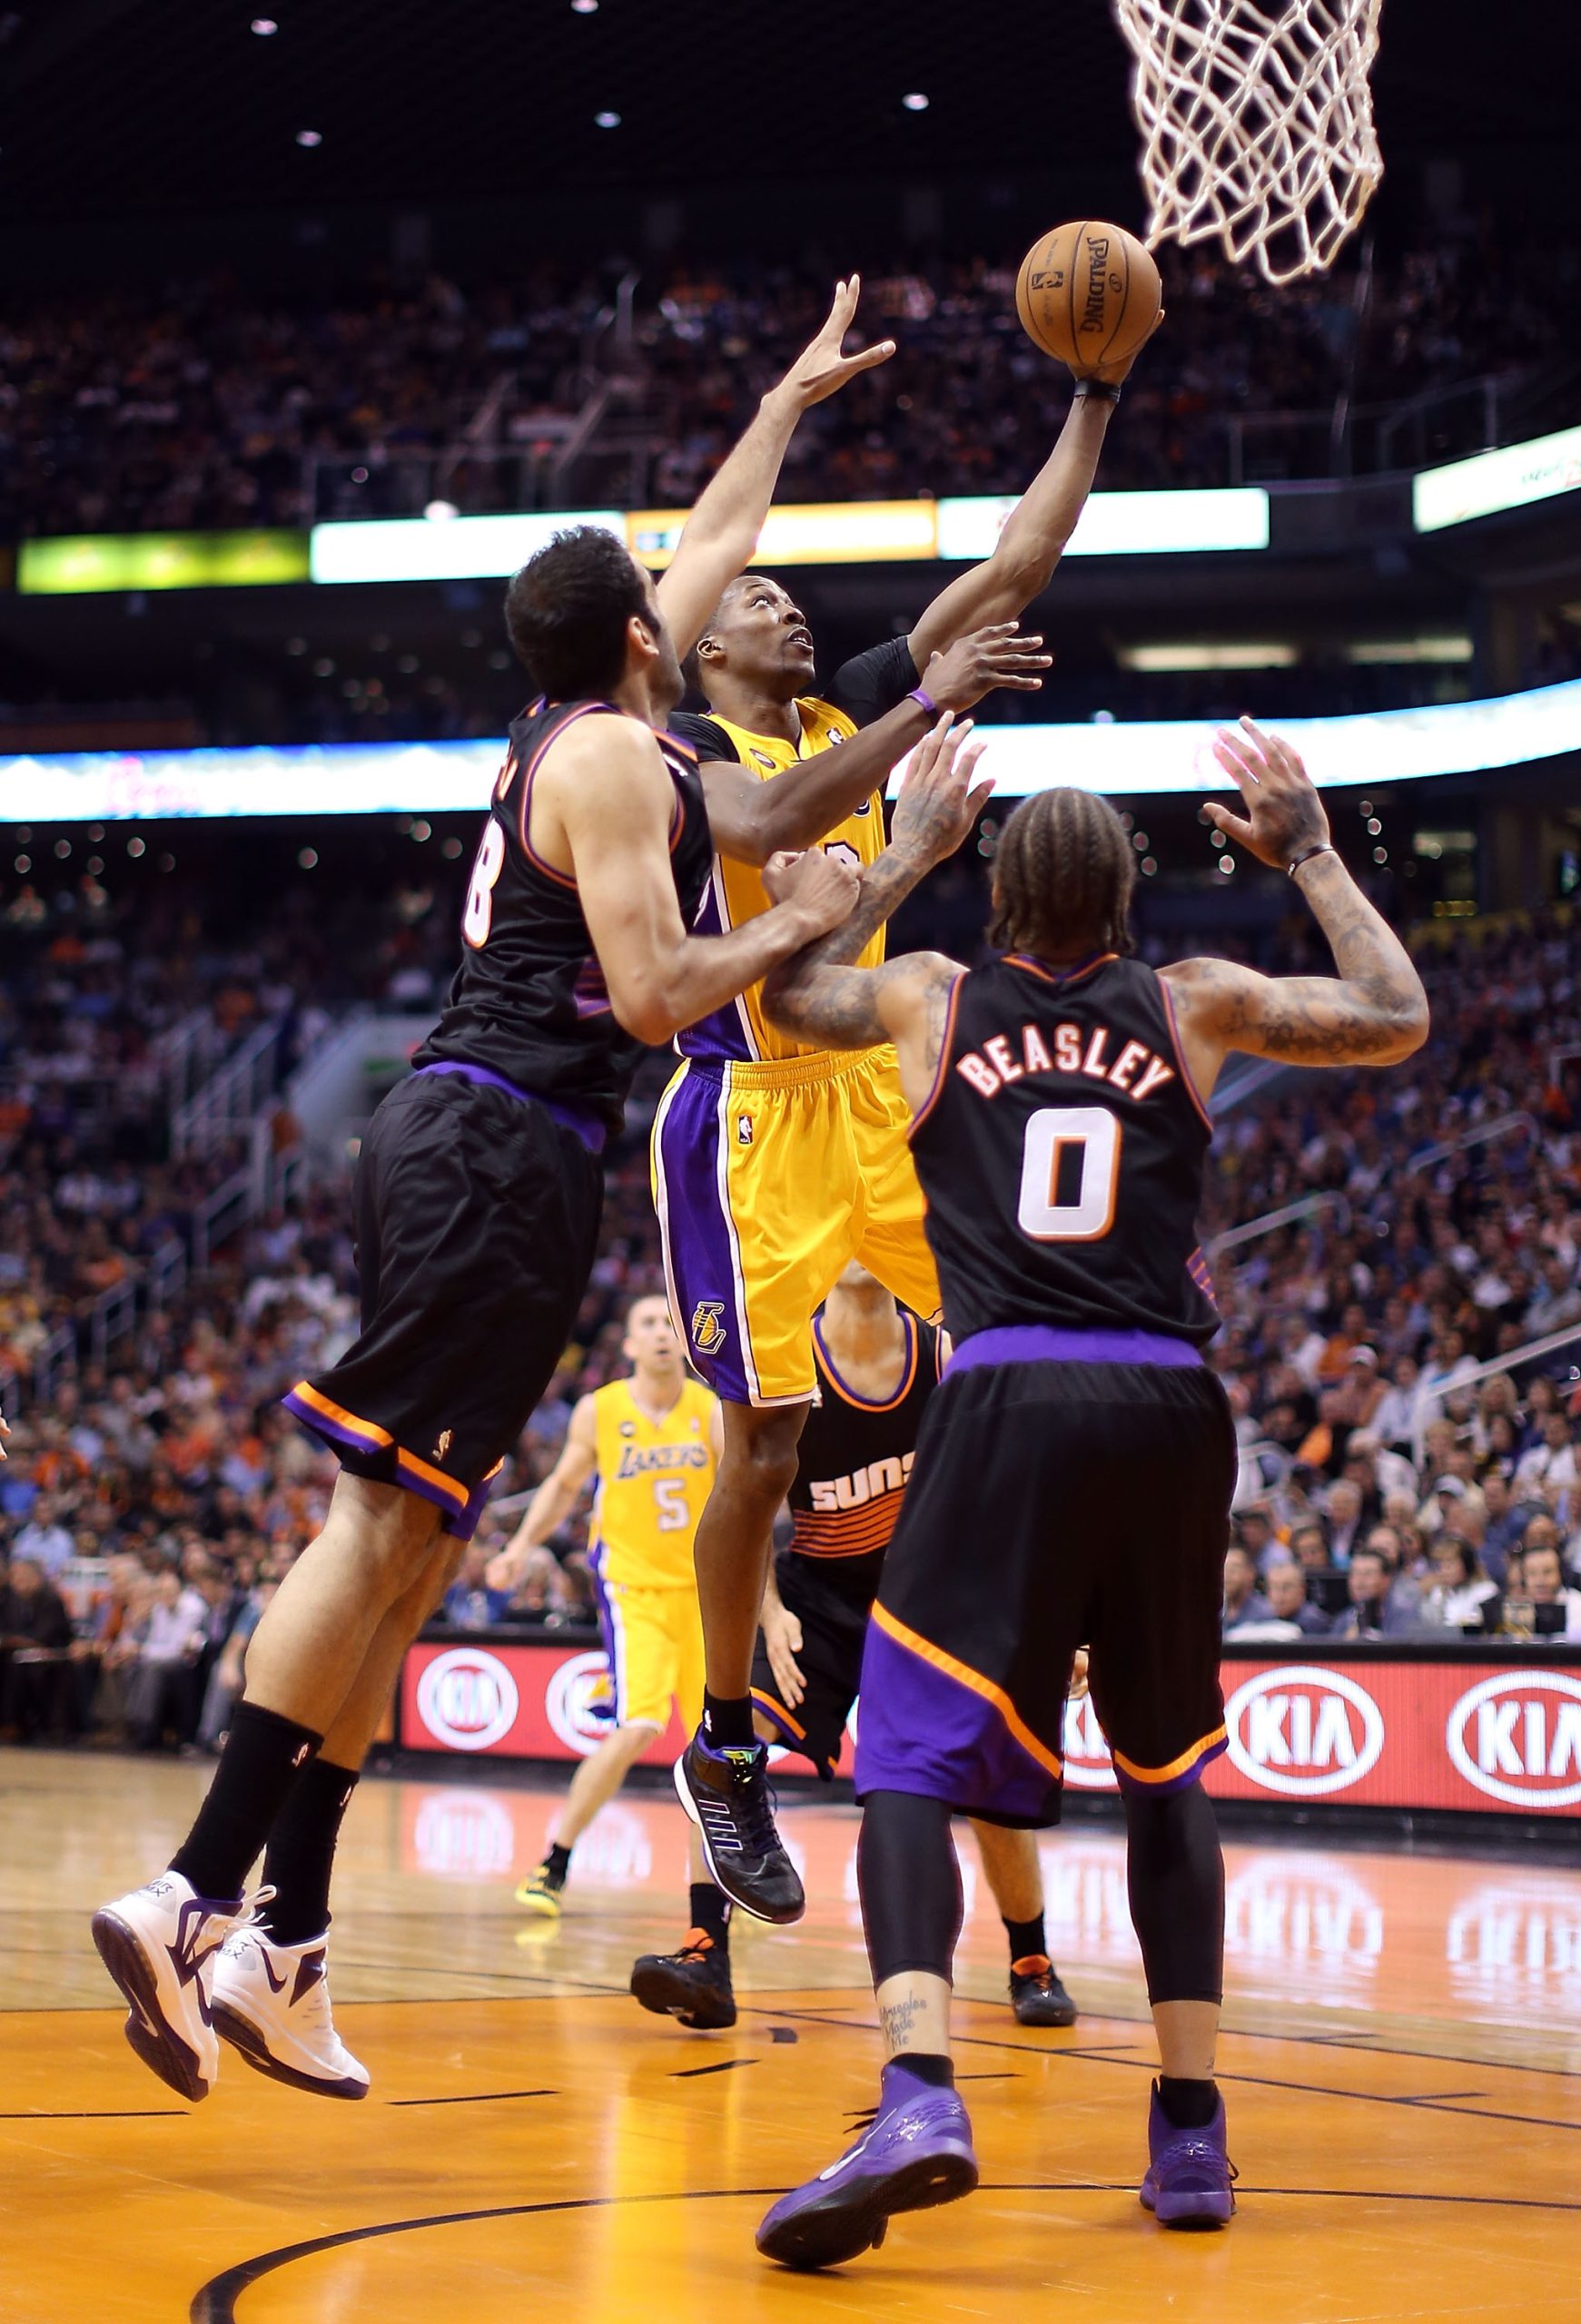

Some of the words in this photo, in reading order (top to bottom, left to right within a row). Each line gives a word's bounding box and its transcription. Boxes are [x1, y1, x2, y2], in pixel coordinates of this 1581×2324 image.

[1080, 237, 1109, 334] SPALDING
[955, 1023, 1175, 1101] BEASLEY
[1017, 1106, 1122, 1244] 0
[653, 1478, 689, 1531] 5
[1249, 1694, 1358, 1768] KIA
